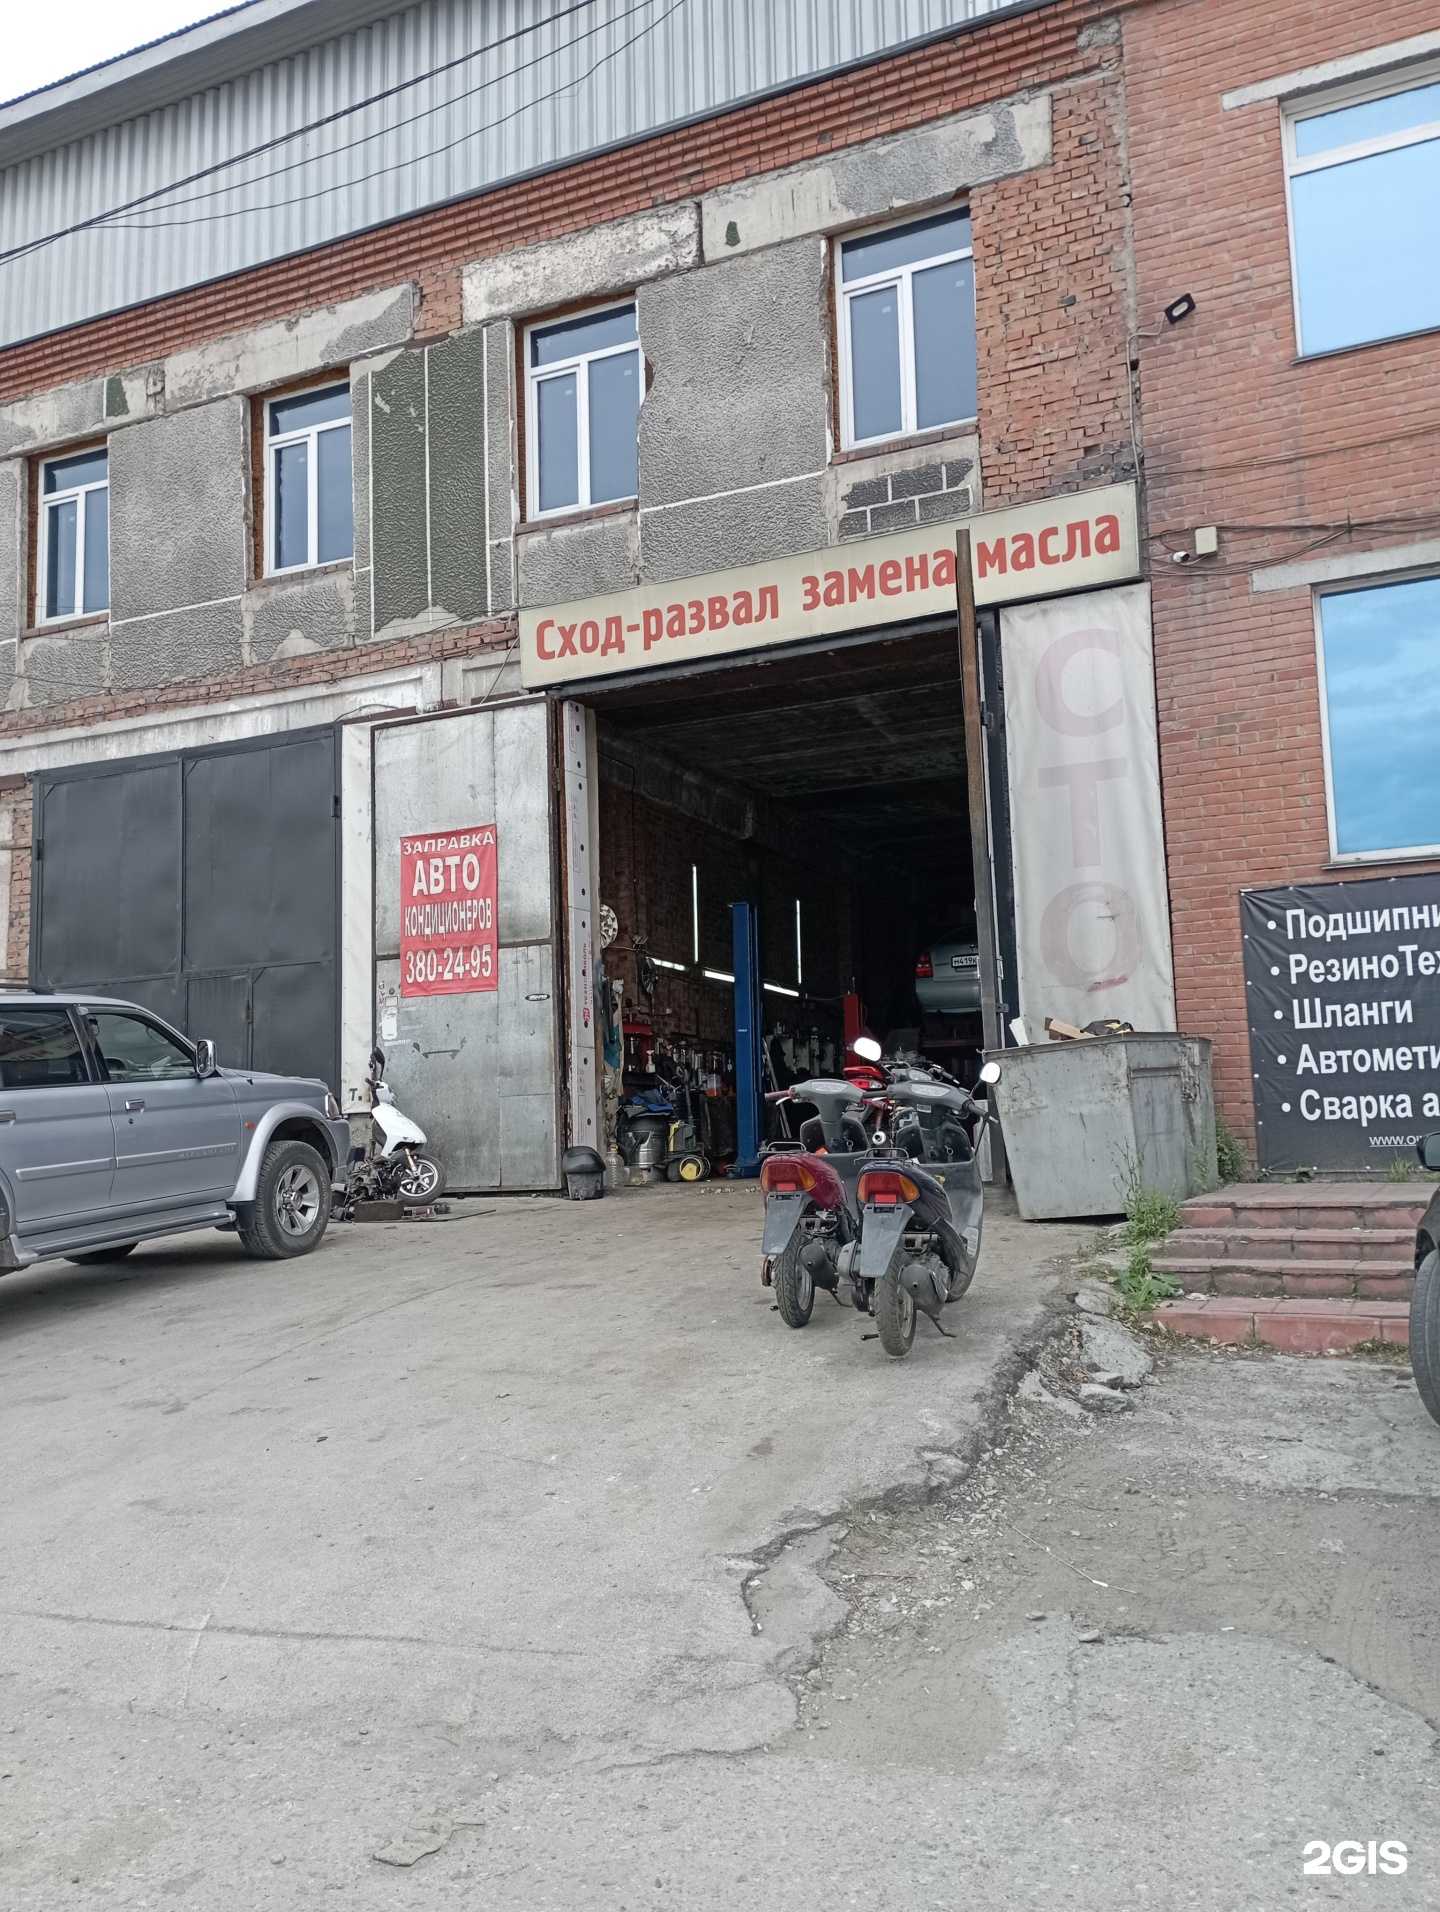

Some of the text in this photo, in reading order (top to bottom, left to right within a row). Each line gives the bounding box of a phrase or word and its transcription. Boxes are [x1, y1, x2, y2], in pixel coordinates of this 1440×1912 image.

[536, 514, 1120, 661] Сход-развал замена масла
[1035, 628, 1143, 992] СТО
[402, 831, 496, 856] ЗАПРАВКА
[412, 853, 480, 897] АВТО
[404, 898, 492, 941] КОНДИЦИОНЕРОВ
[405, 943, 492, 984] 380-24-95
[1292, 997, 1413, 1030] Шланги
[1300, 1088, 1413, 1127] Сварка
